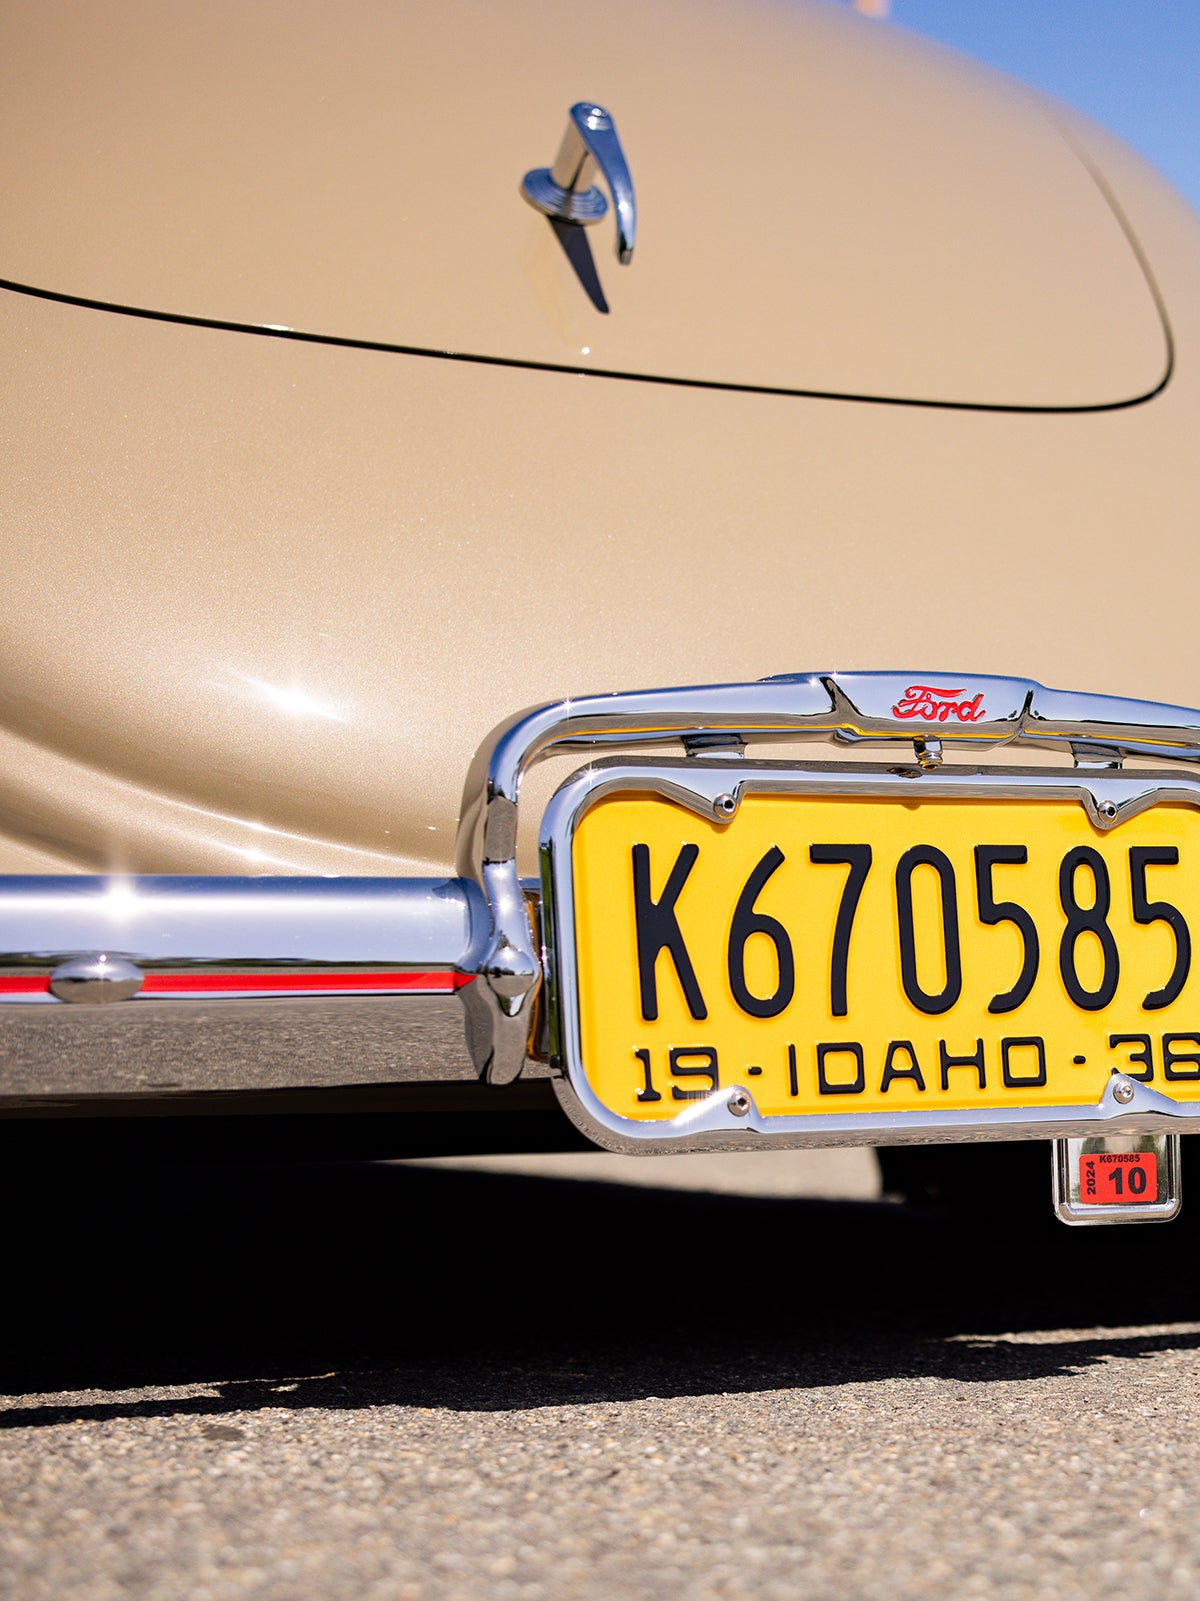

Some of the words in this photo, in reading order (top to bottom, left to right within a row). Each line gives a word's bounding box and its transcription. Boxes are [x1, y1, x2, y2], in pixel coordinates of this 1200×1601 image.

[892, 685, 986, 722] Ford
[632, 843, 1191, 1021] K670585
[635, 1046, 718, 1101] 19
[787, 1036, 1045, 1096] IDAHO
[1099, 1154, 1140, 1163] K670585
[1086, 1161, 1096, 1195] 2024
[1108, 1167, 1146, 1194] 10
